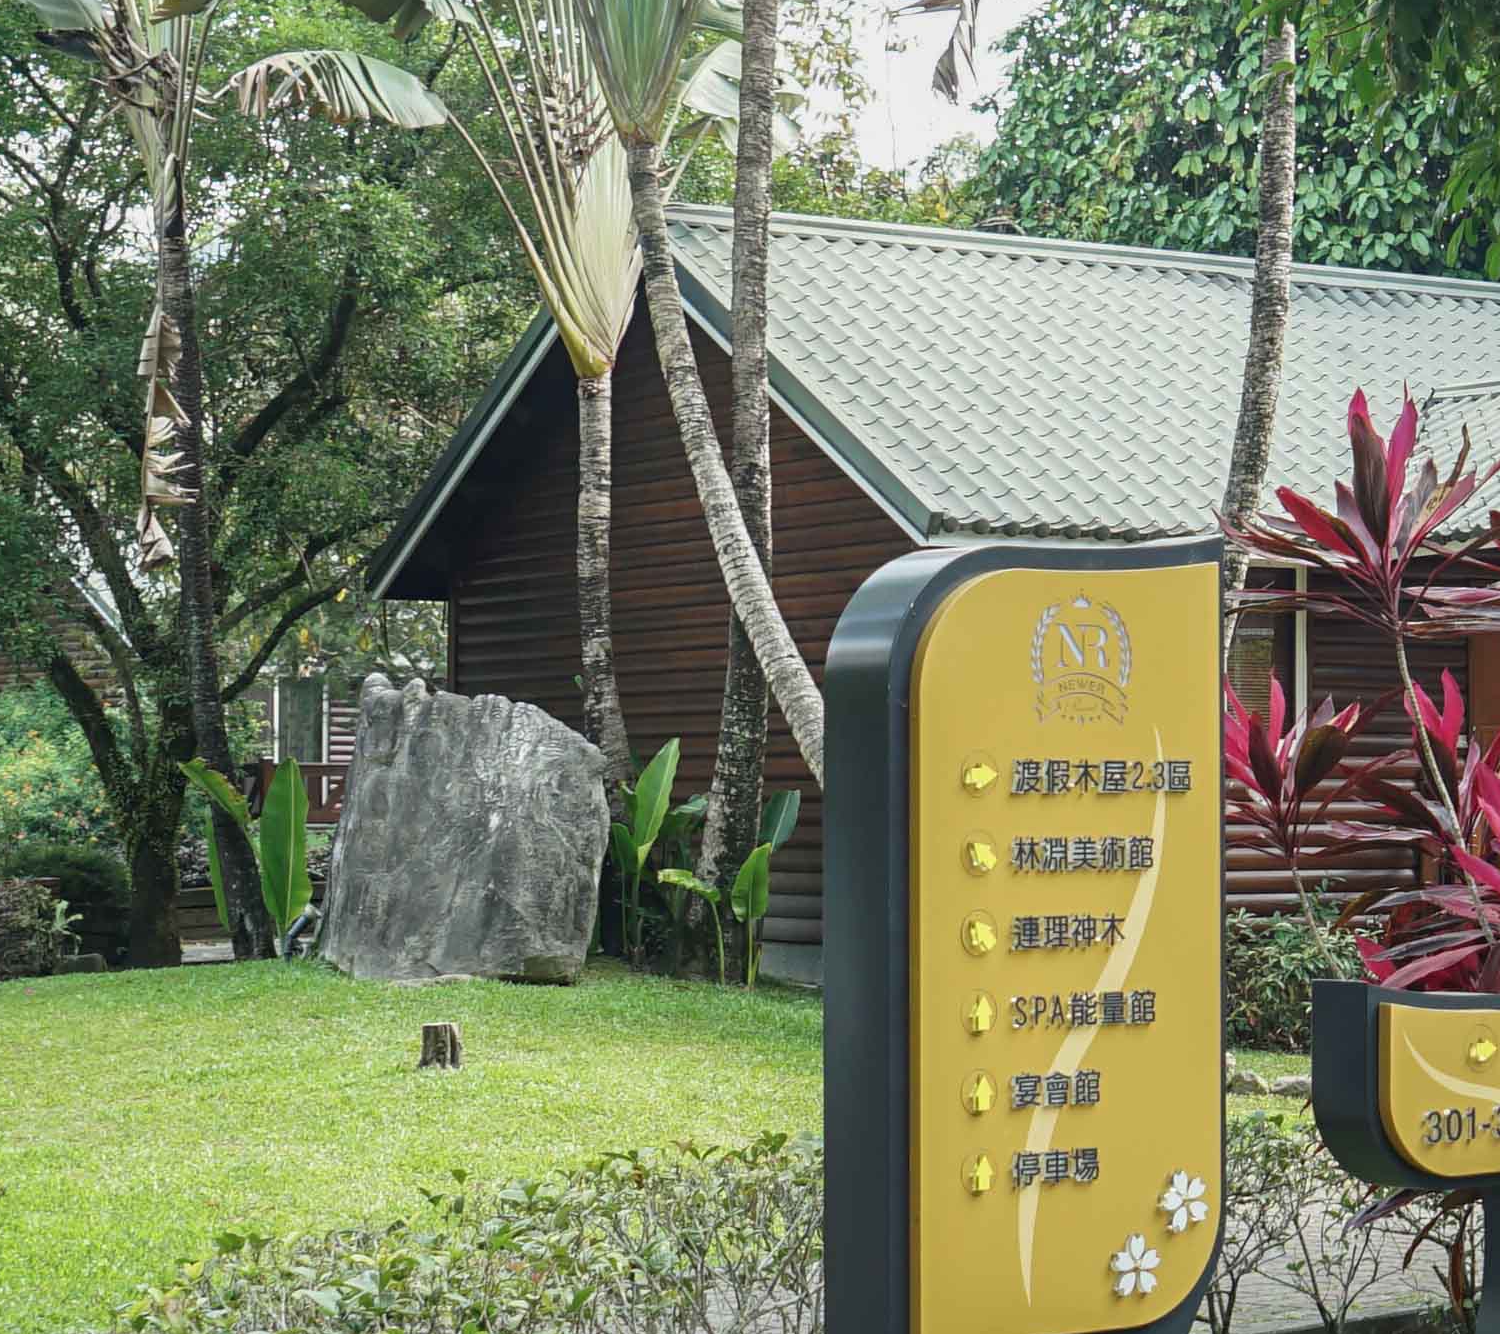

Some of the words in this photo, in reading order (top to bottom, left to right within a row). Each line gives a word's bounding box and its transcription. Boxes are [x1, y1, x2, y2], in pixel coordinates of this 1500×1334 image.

[1013, 759, 1191, 793] 渡假木屋2.3區
[1013, 836, 1154, 870] 林淵美術館
[1013, 914, 1125, 949] 連理神木
[1014, 990, 1156, 1027] SPA能量館
[1013, 1069, 1100, 1107] 宴會館
[1013, 1148, 1100, 1186] 停車場
